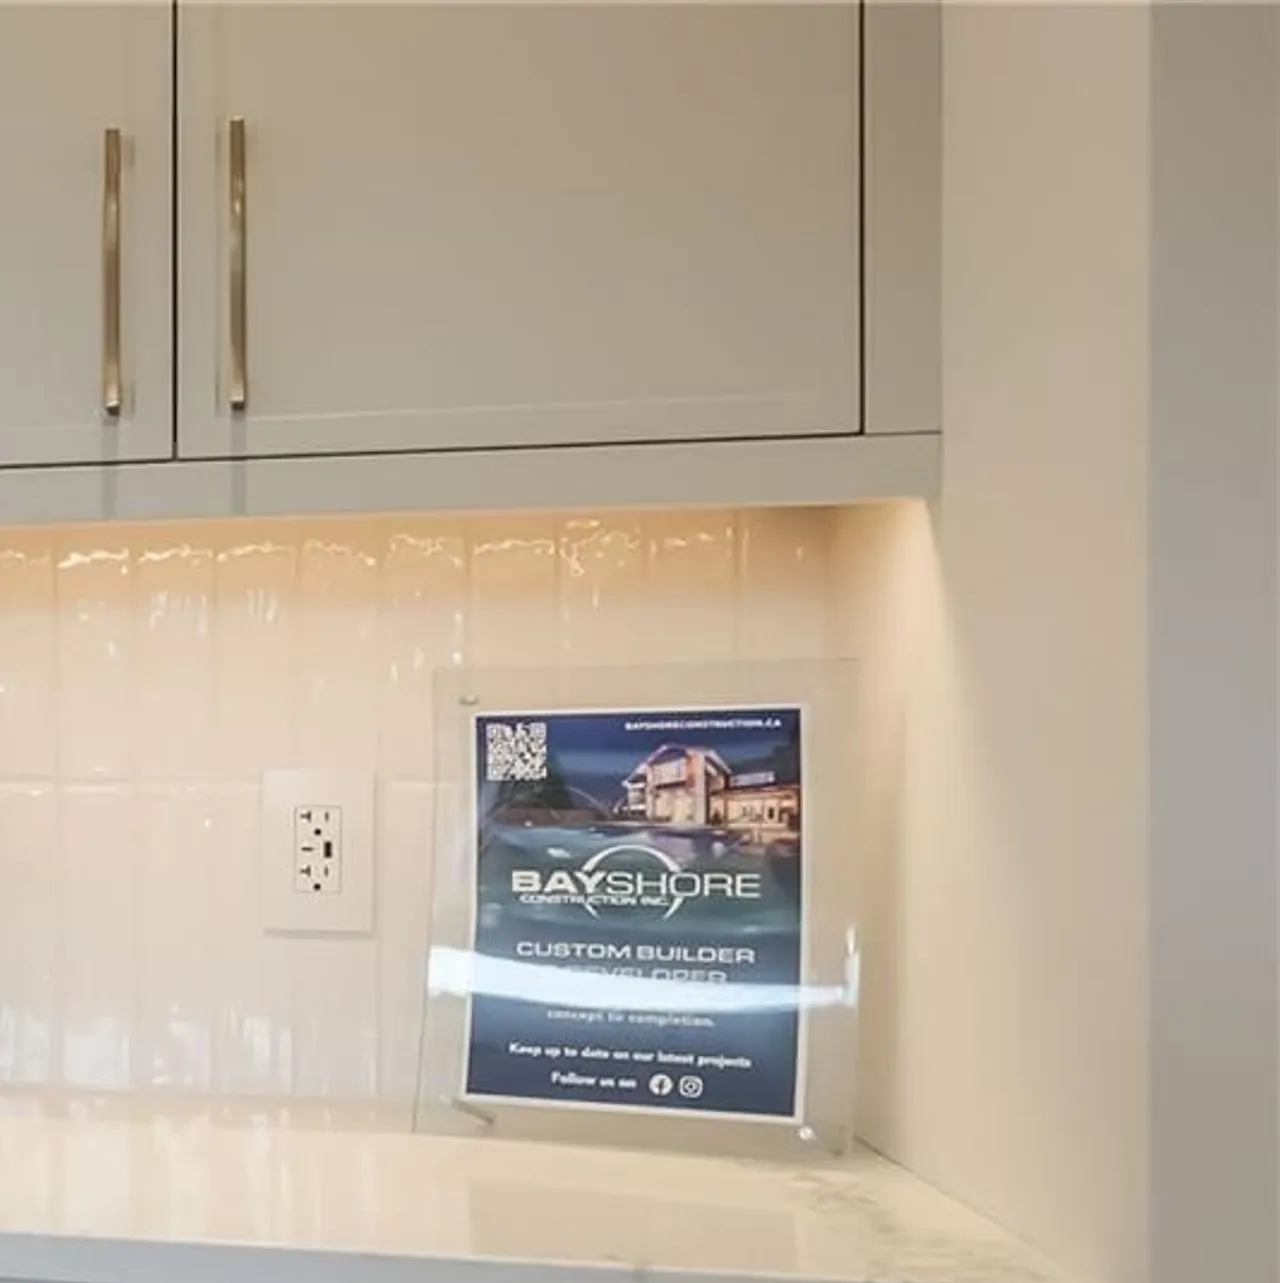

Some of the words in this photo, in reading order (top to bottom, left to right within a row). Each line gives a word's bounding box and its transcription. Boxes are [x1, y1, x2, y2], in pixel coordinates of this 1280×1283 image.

[511, 869, 762, 898] BAYSHORE
[518, 893, 638, 906] CONSTRUCTION
[516, 941, 632, 959] CUSTOM
[636, 945, 756, 965] BUILDER
[509, 1041, 542, 1058] Keep
[544, 1046, 561, 1059] up
[563, 1046, 578, 1058] to
[581, 1045, 610, 1059] date
[612, 1050, 629, 1060] on
[632, 1052, 655, 1062] our
[657, 1049, 694, 1065] latest
[696, 1053, 752, 1070] projects
[551, 1070, 596, 1086] Follow
[599, 1077, 615, 1088] us
[618, 1078, 637, 1089] on
